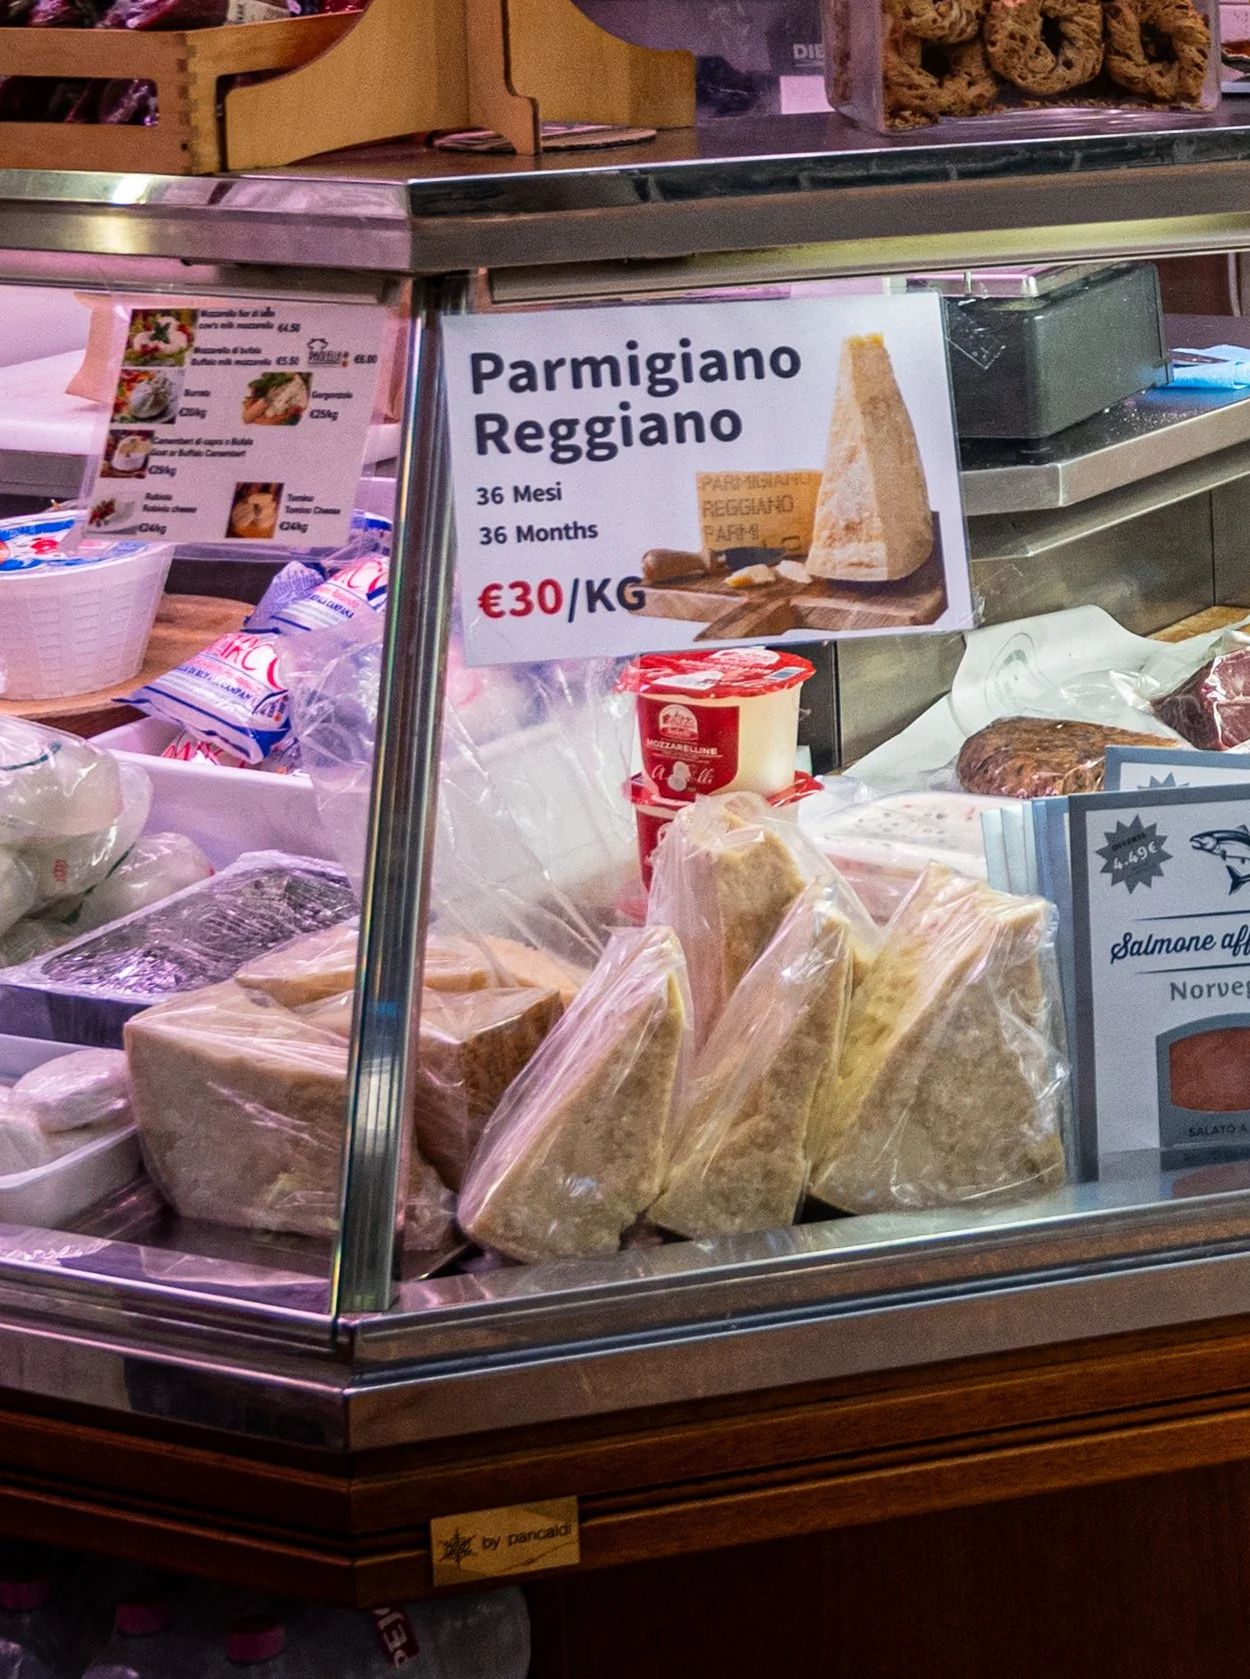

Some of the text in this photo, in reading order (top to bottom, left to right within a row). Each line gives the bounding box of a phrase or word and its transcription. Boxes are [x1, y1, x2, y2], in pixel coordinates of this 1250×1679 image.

[470, 337, 801, 399] Parmigiano
[474, 400, 743, 465] Reggiano
[476, 481, 564, 506] 36 Mesi
[702, 494, 794, 518] REGGIANO
[478, 520, 599, 547] 36 Months
[476, 574, 648, 624] €30/KG
[1110, 930, 1216, 965] Salmone
[1188, 1124, 1236, 1138] SALATO
[482, 1535, 501, 1551] by
